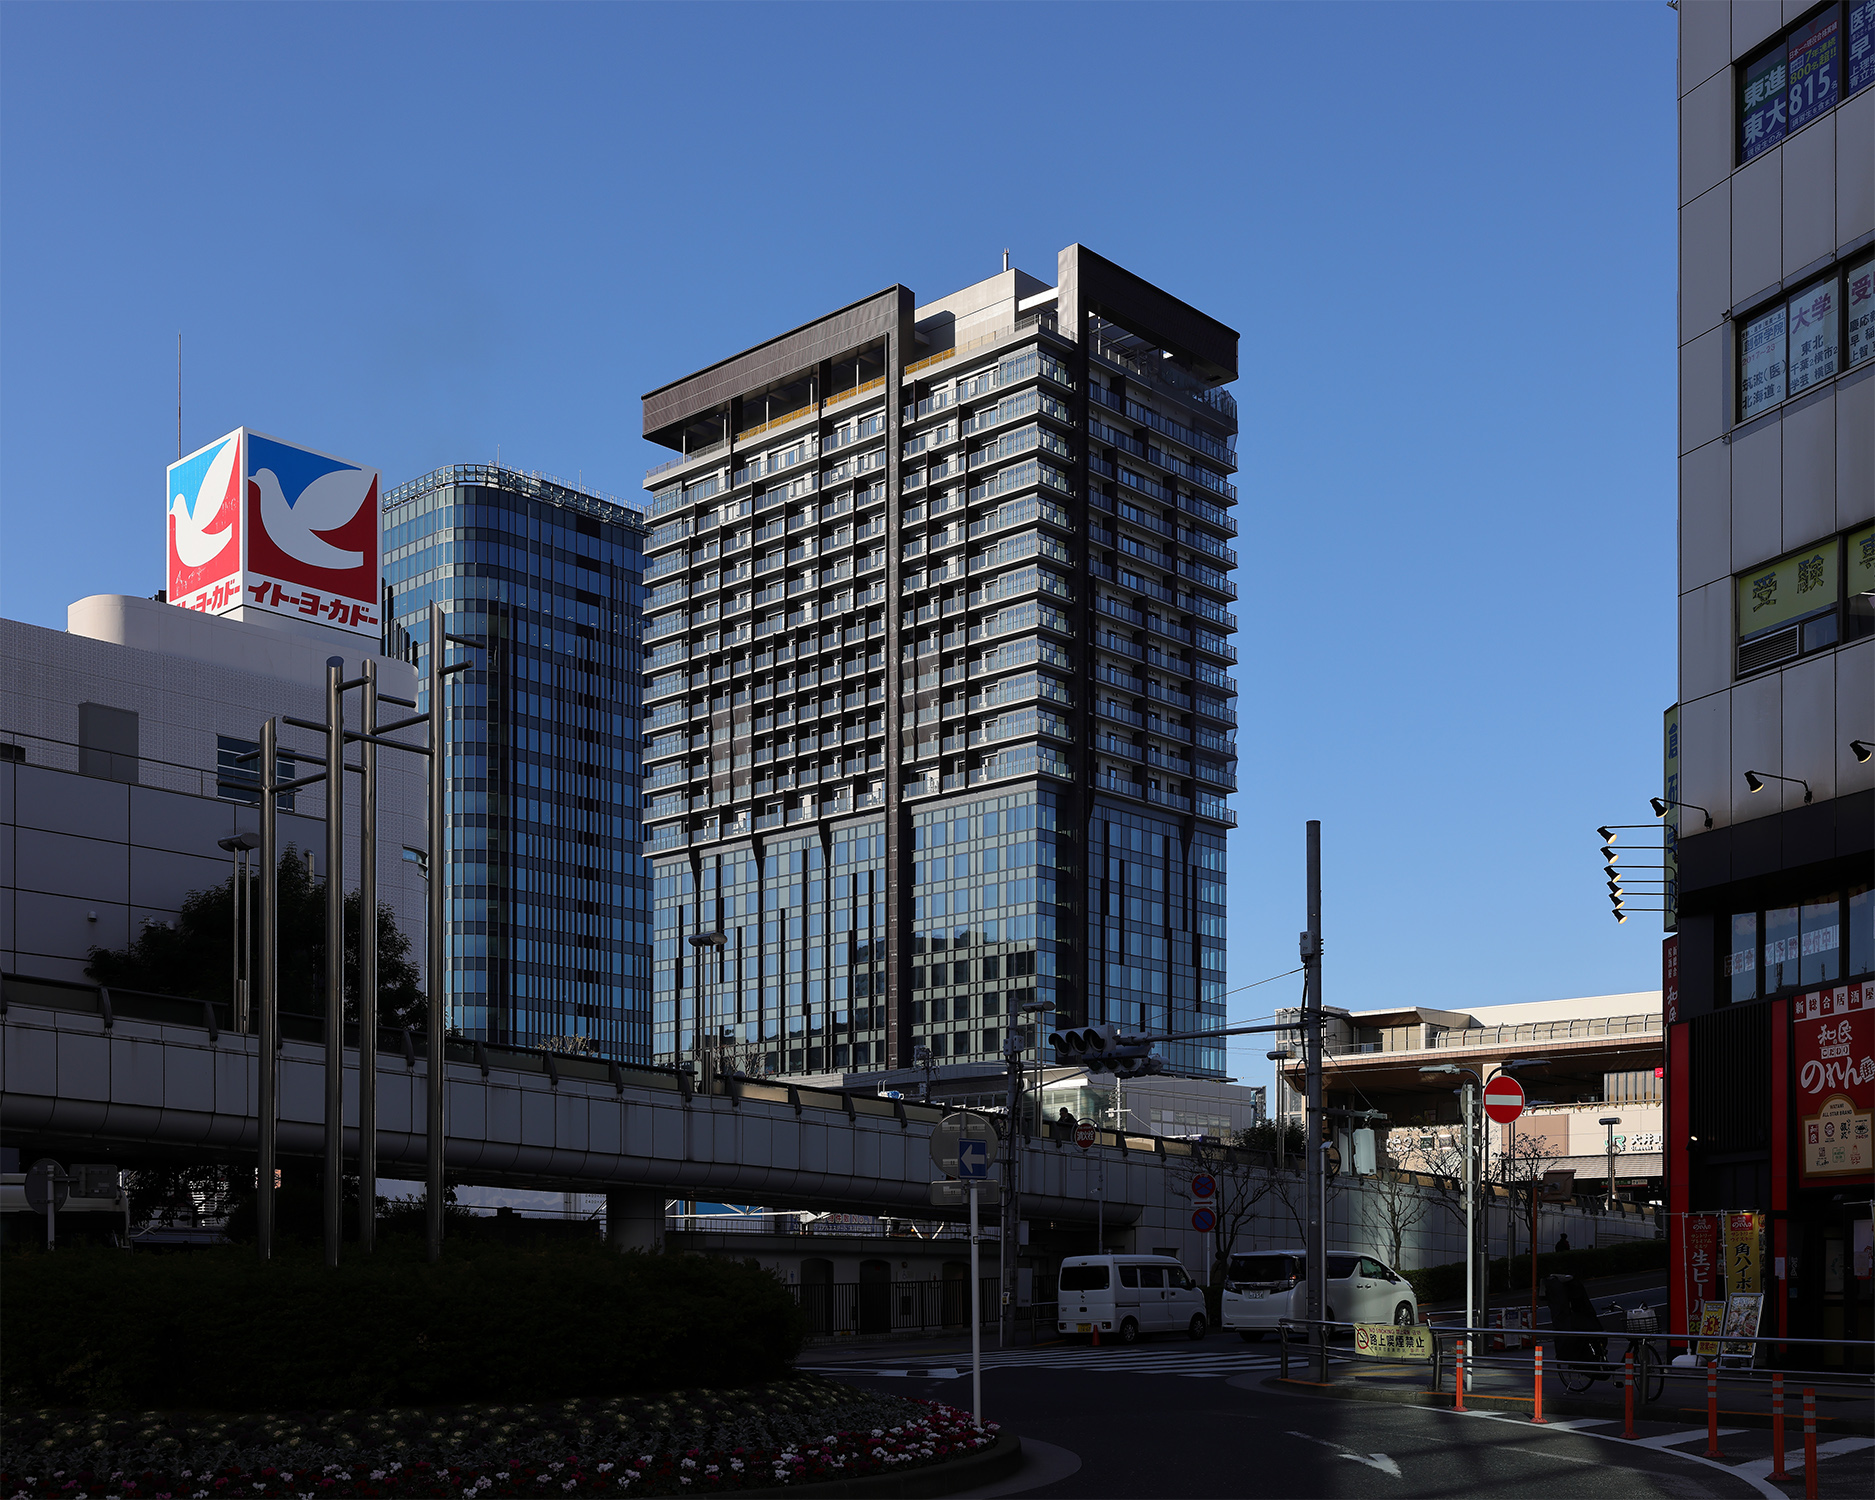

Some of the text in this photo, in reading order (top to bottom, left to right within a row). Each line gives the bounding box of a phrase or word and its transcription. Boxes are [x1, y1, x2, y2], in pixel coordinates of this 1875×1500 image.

[1804, 36, 1836, 63] 7年連続
[1743, 64, 1786, 112] 東進
[1789, 63, 1838, 116] 815名
[1743, 98, 1786, 149] 東大
[1791, 293, 1831, 334] 大学
[1851, 271, 1875, 306] 受
[1744, 321, 1784, 352] 創研学院
[1801, 334, 1824, 356] 東北
[1752, 554, 1825, 612] 受験
[248, 581, 378, 627] イトーヨーカドー
[1795, 987, 1874, 1015] 新総合居酒屋
[1817, 1020, 1853, 1046] 和民
[1822, 1046, 1848, 1058] こだわり
[1734, 1242, 1752, 1293] 角ハイボ
[1370, 1334, 1424, 1348] 路上喫煙禁止
